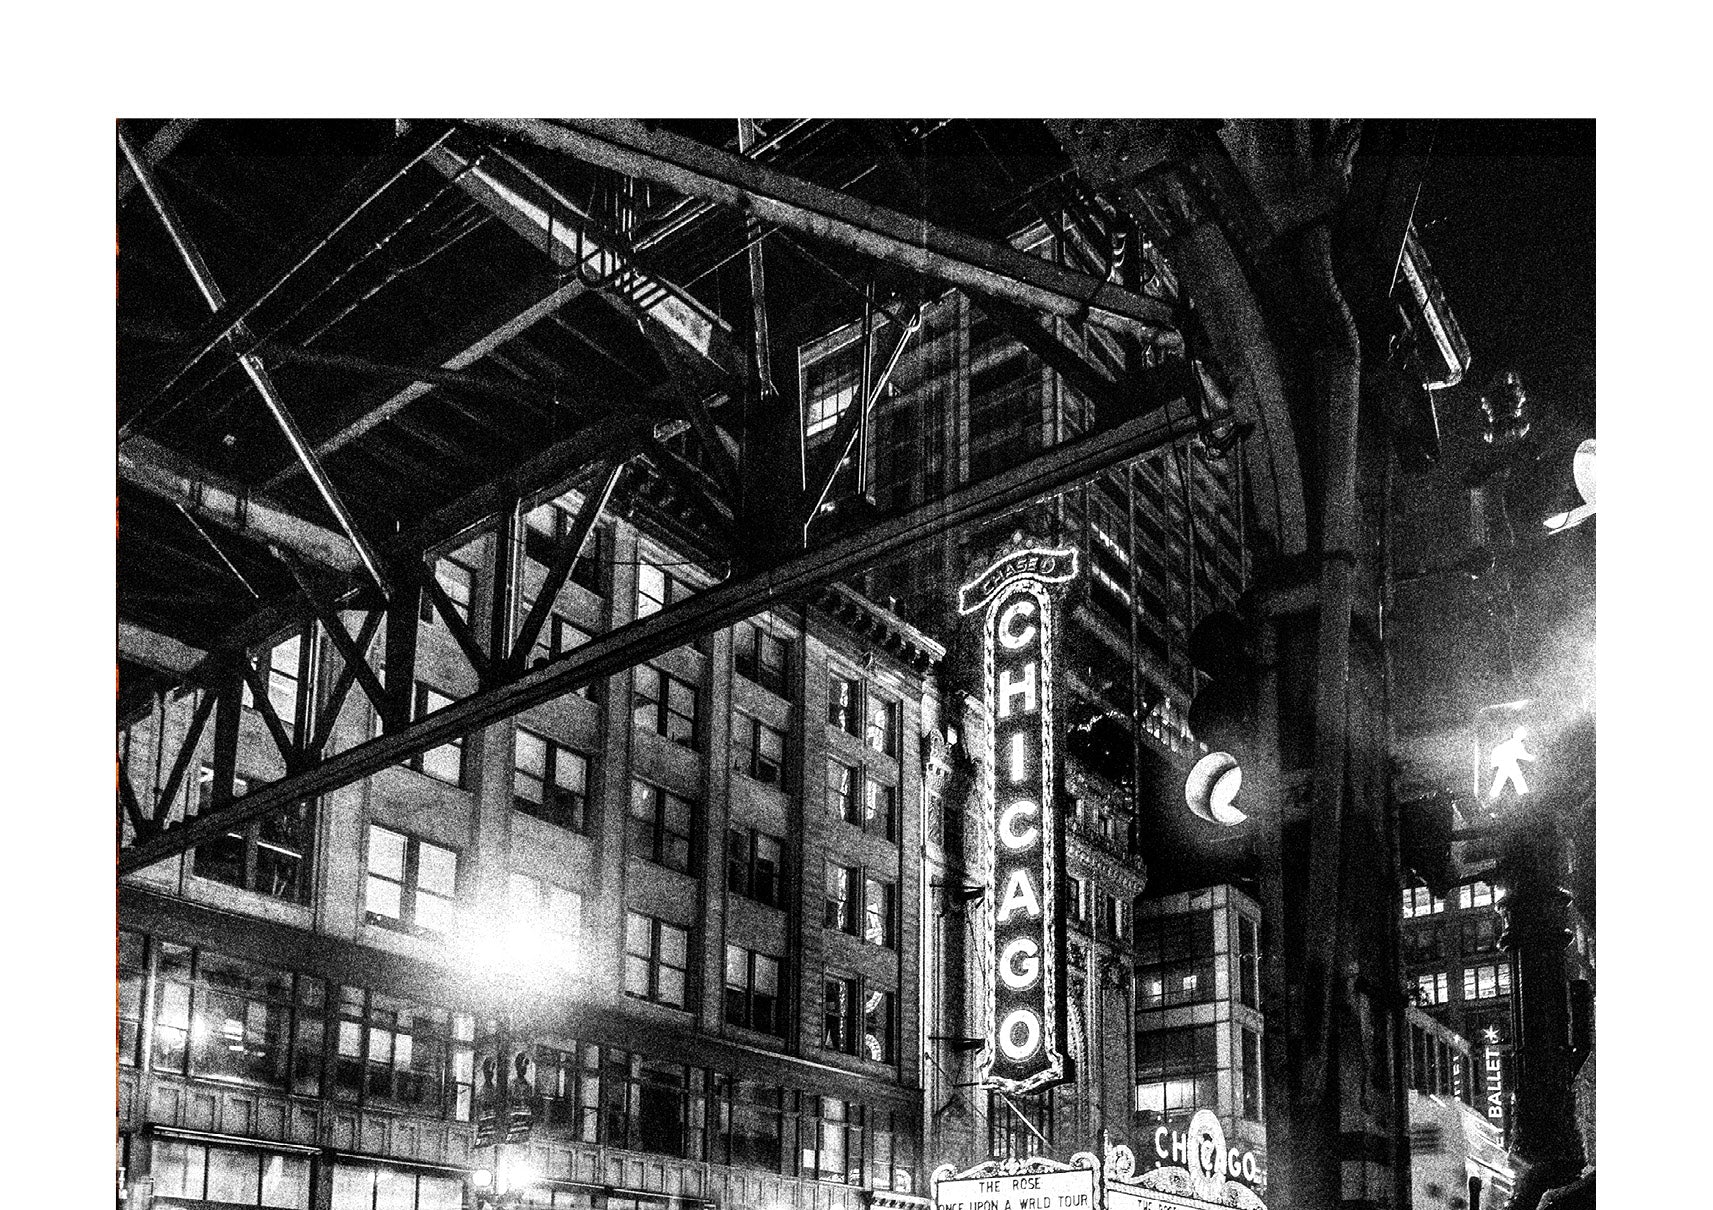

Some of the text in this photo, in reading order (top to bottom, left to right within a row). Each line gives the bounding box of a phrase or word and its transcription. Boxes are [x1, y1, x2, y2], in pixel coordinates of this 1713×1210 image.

[983, 557, 1039, 595] CHASE
[998, 600, 1041, 1060] CHICAGO
[1485, 1047, 1503, 1118] BALLET
[979, 1177, 1041, 1193] THE ROSE
[1004, 1199, 1012, 1210] A
[1019, 1196, 1051, 1210] WRLD
[1058, 1194, 1088, 1208] TOUR
